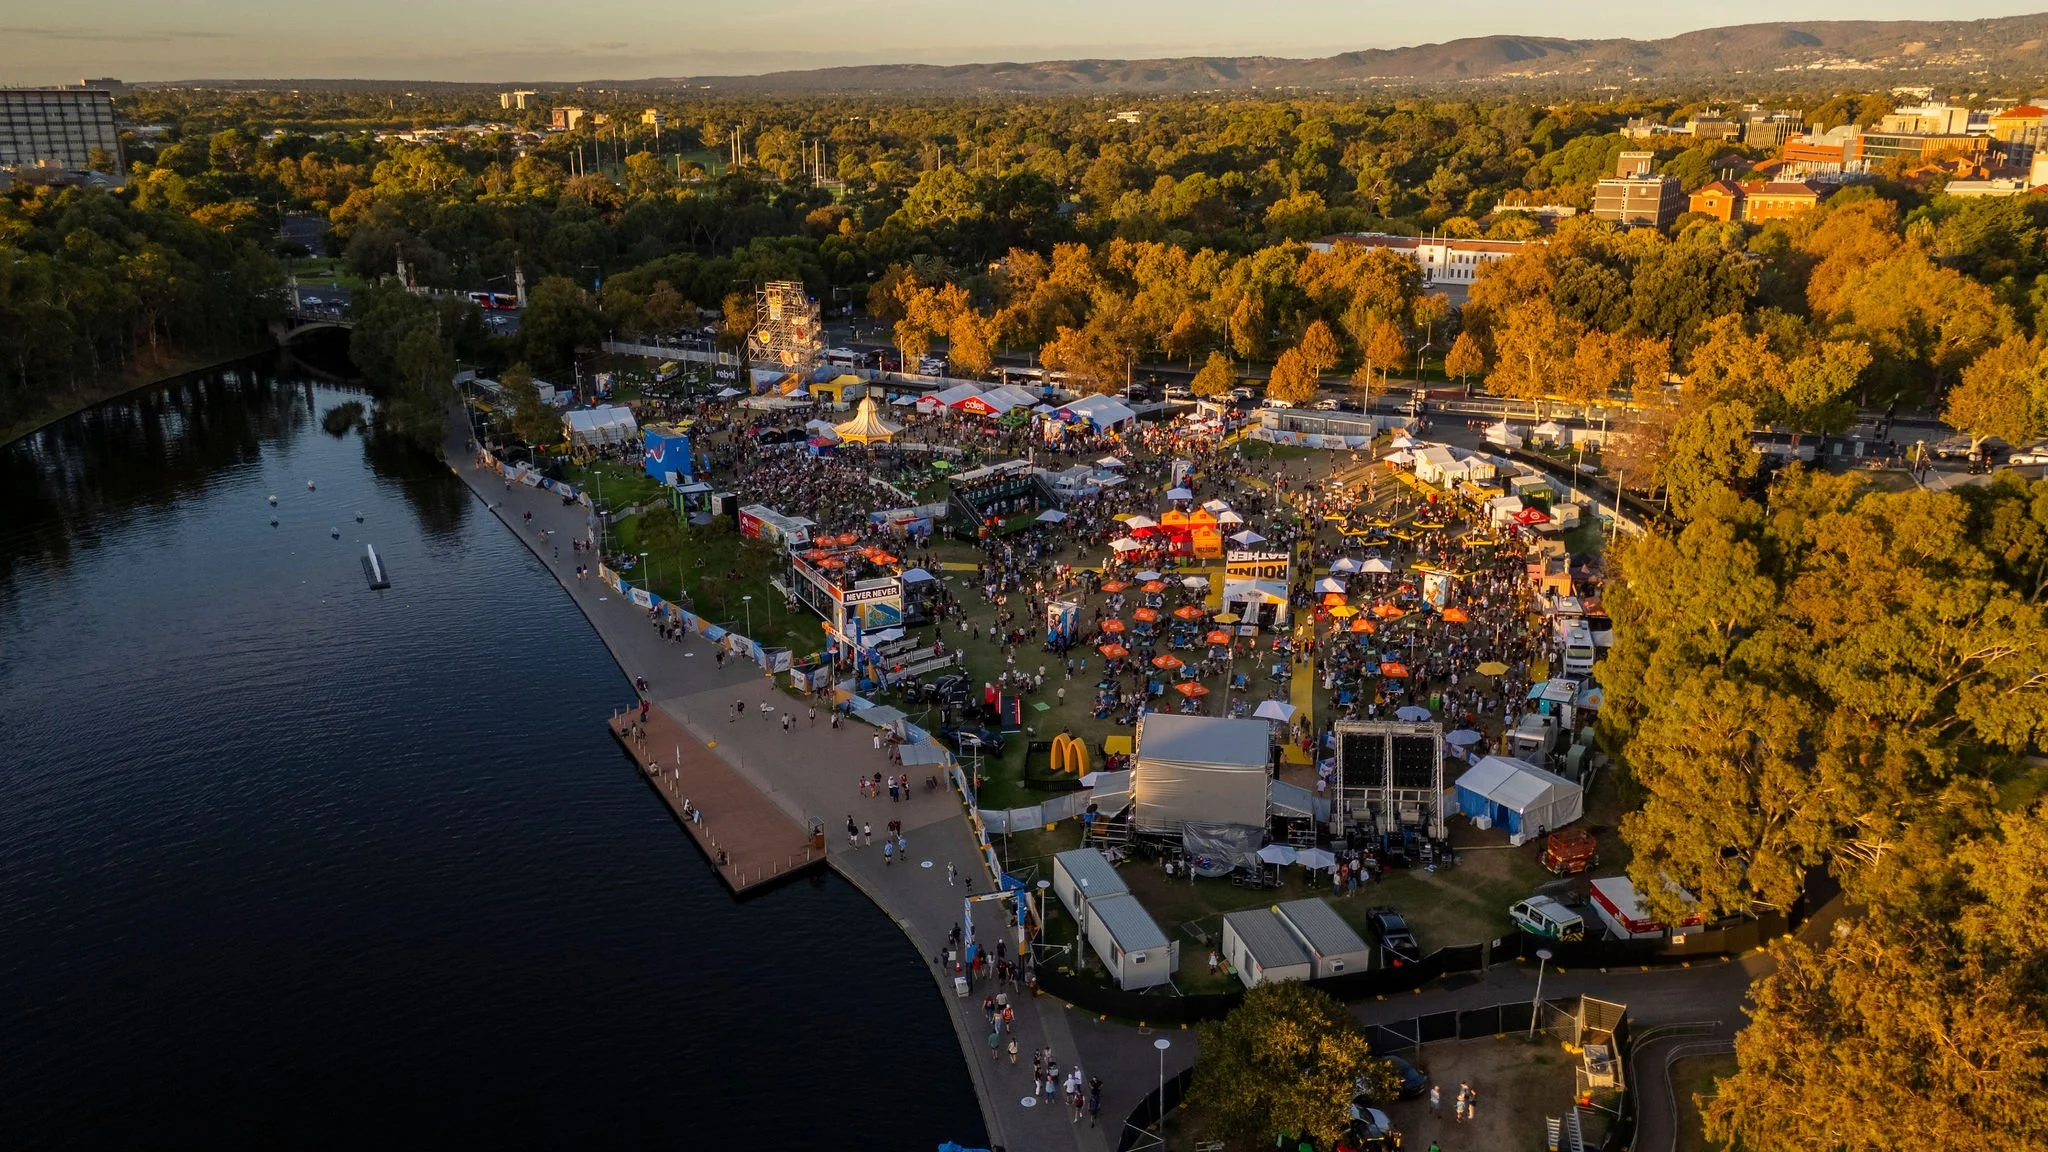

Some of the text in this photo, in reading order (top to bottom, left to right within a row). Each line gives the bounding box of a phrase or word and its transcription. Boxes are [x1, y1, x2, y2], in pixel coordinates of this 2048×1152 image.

[716, 369, 736, 379] rebel
[965, 400, 985, 411] coles
[1010, 477, 1032, 489] LIFE
[1227, 564, 1287, 579] ROUND
[846, 587, 897, 601] NEVER NEVER
